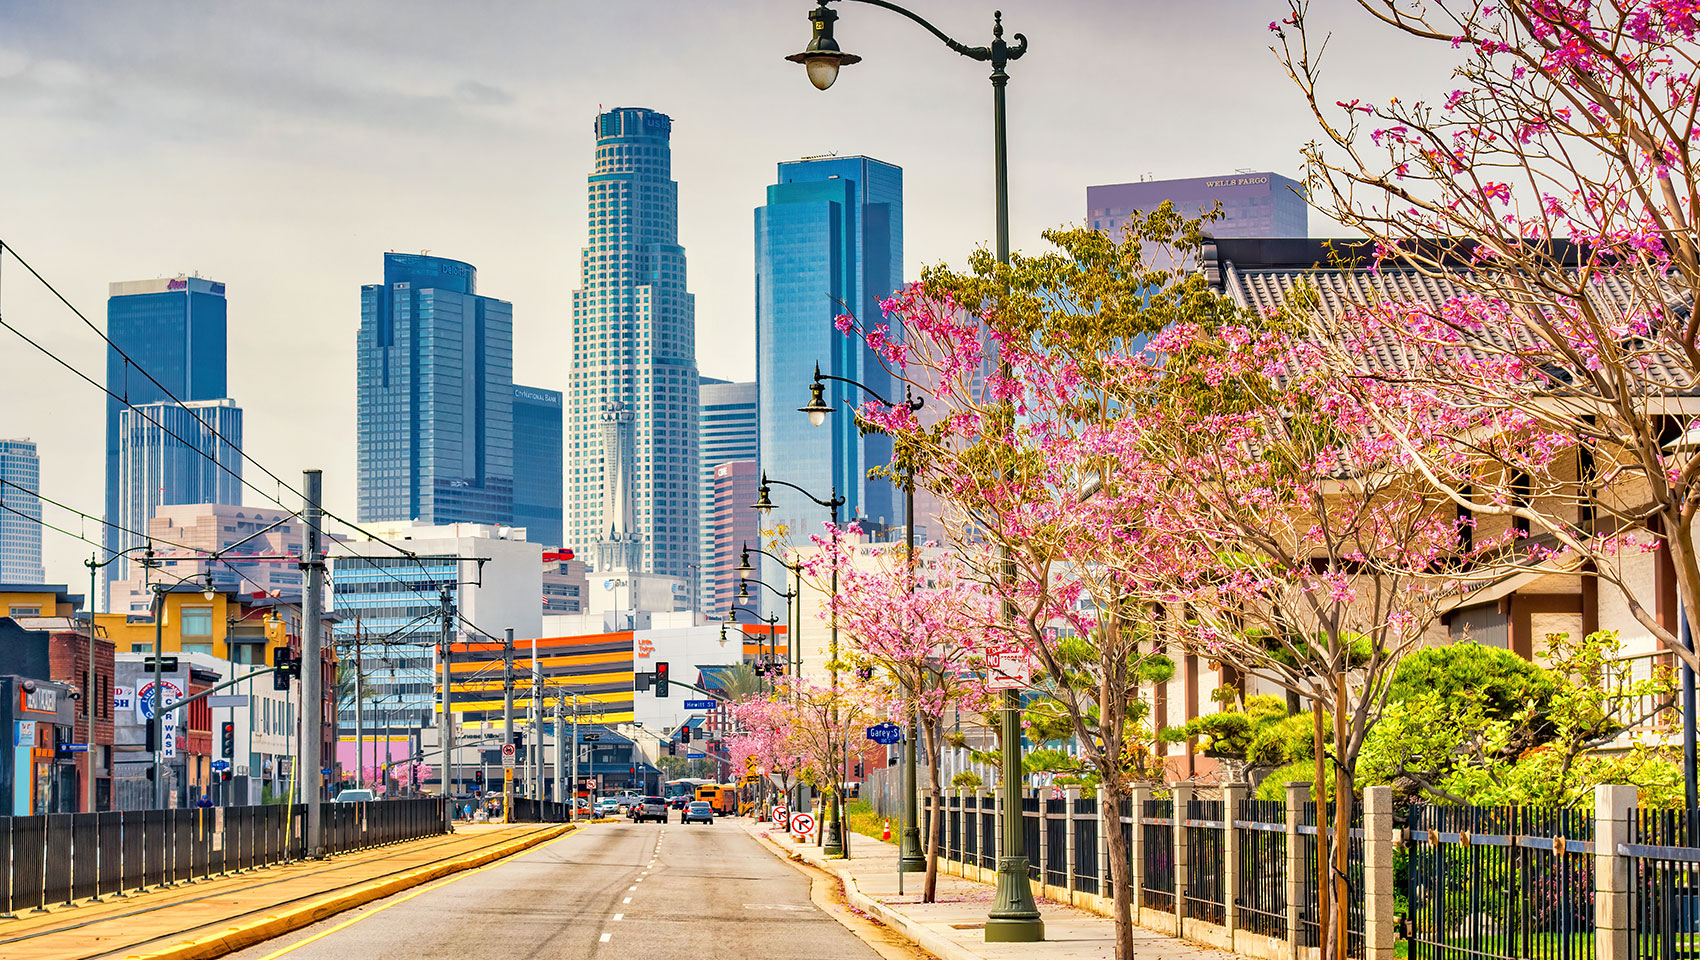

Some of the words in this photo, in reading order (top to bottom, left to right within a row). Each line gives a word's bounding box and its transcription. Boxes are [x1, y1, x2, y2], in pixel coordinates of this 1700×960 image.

[1206, 180, 1236, 188] WELLS
[1238, 176, 1267, 186] FARGO
[988, 655, 999, 666] NO
[165, 698, 173, 720] CR
[870, 728, 891, 739] Garey
[165, 725, 174, 756] WASH
